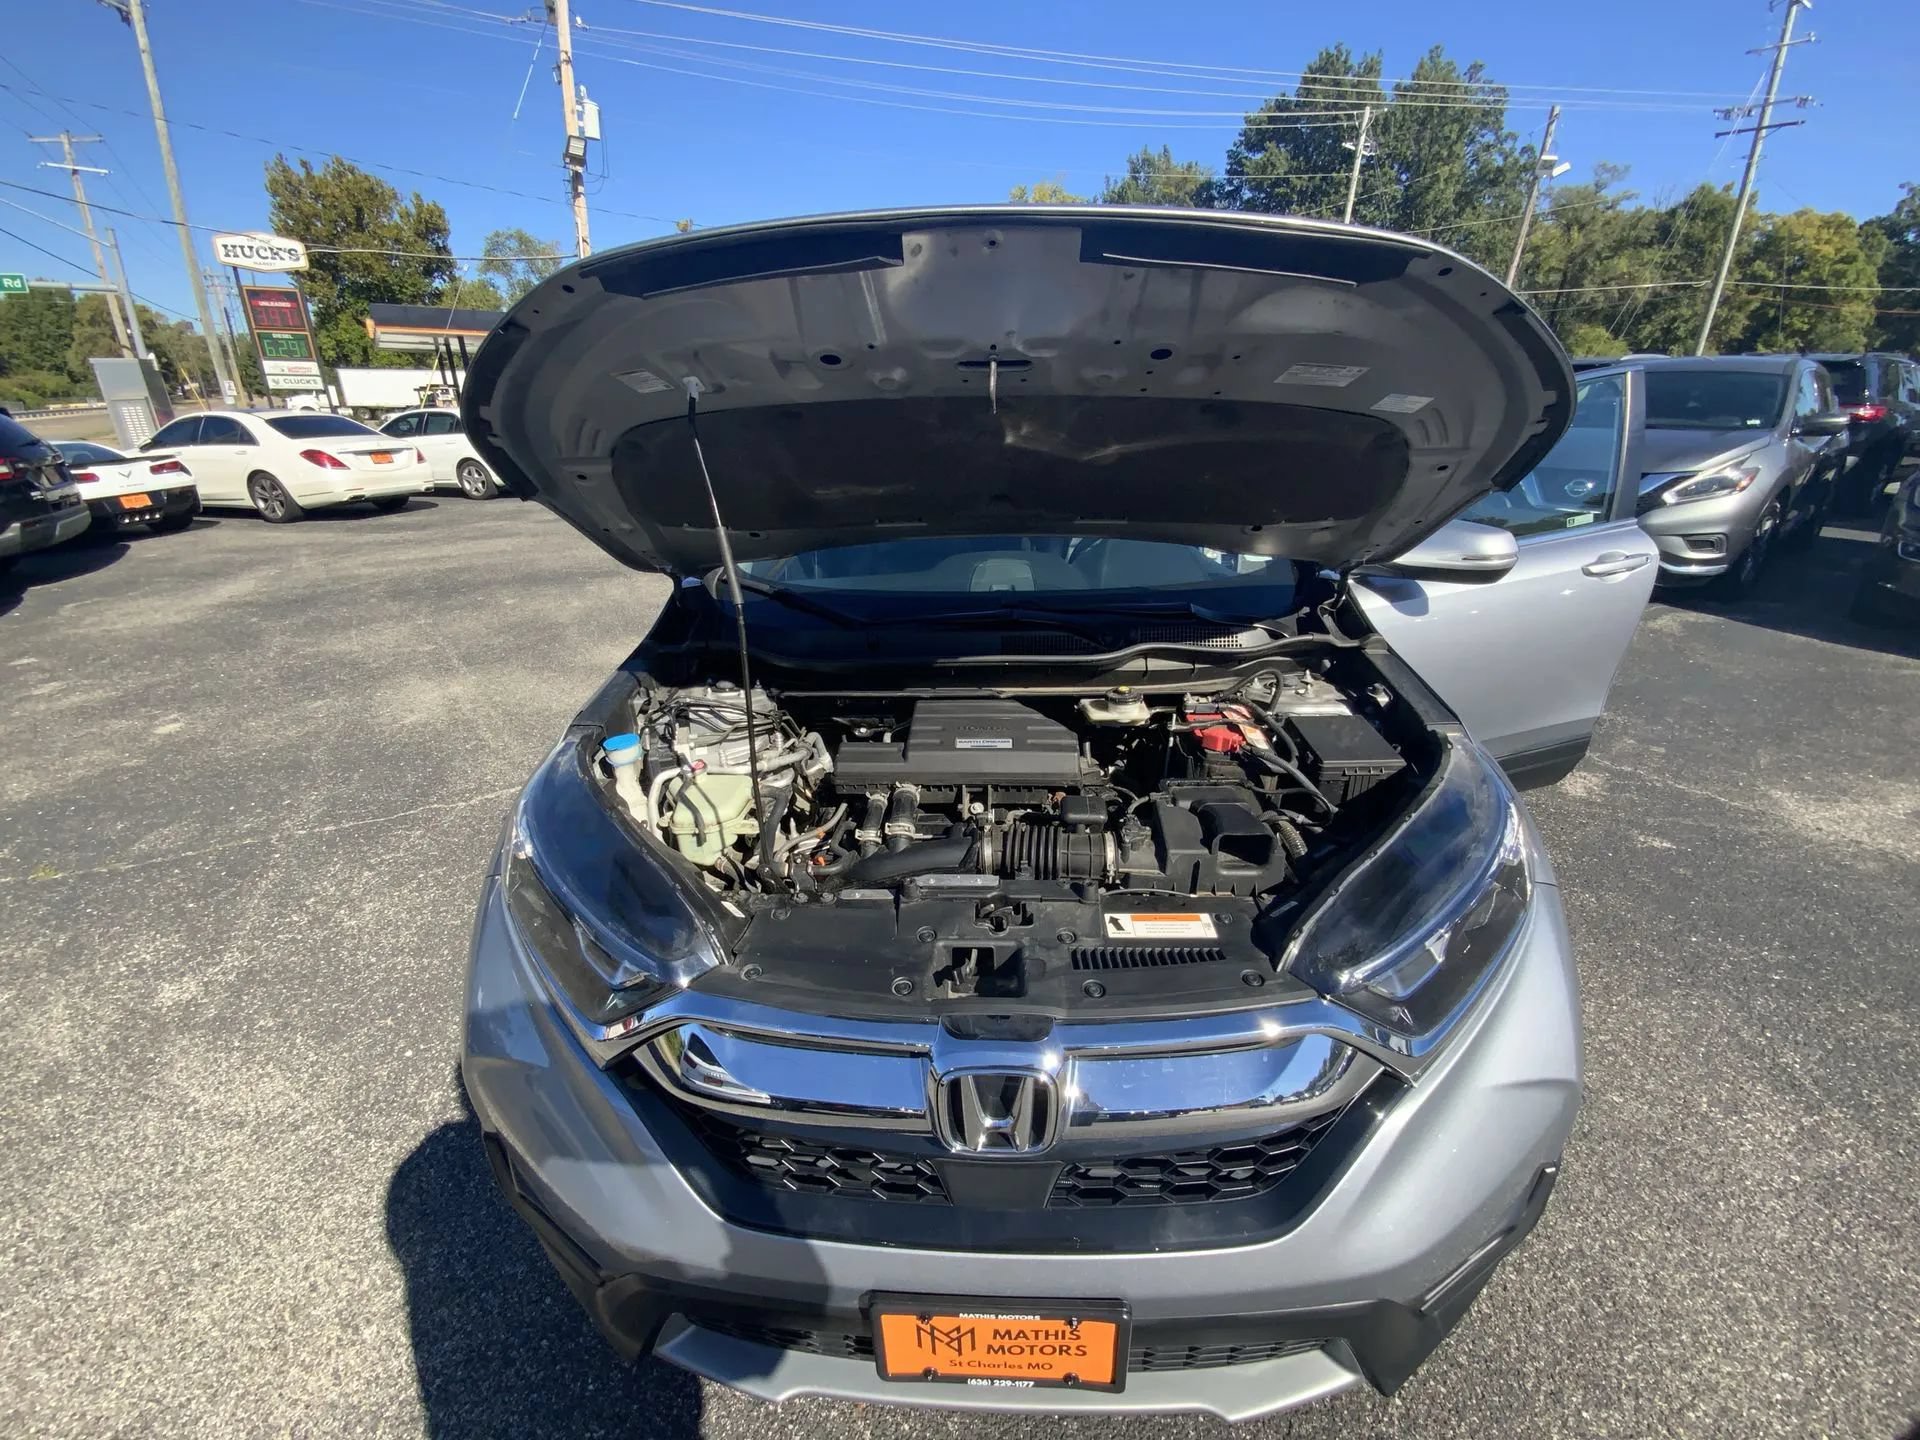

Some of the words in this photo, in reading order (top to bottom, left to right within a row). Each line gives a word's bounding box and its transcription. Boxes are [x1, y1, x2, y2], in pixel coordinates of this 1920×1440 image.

[221, 244, 301, 262] HUCK'S
[3, 278, 22, 288] Rd
[992, 1328, 1082, 1341] MATHIS
[986, 1344, 1088, 1357] MOTORS
[949, 1359, 962, 1368] St
[967, 1360, 1023, 1370] Charles
[1027, 1362, 1054, 1371] MO
[967, 1378, 991, 1387] (636)
[993, 1379, 1035, 1388] 229-1177
